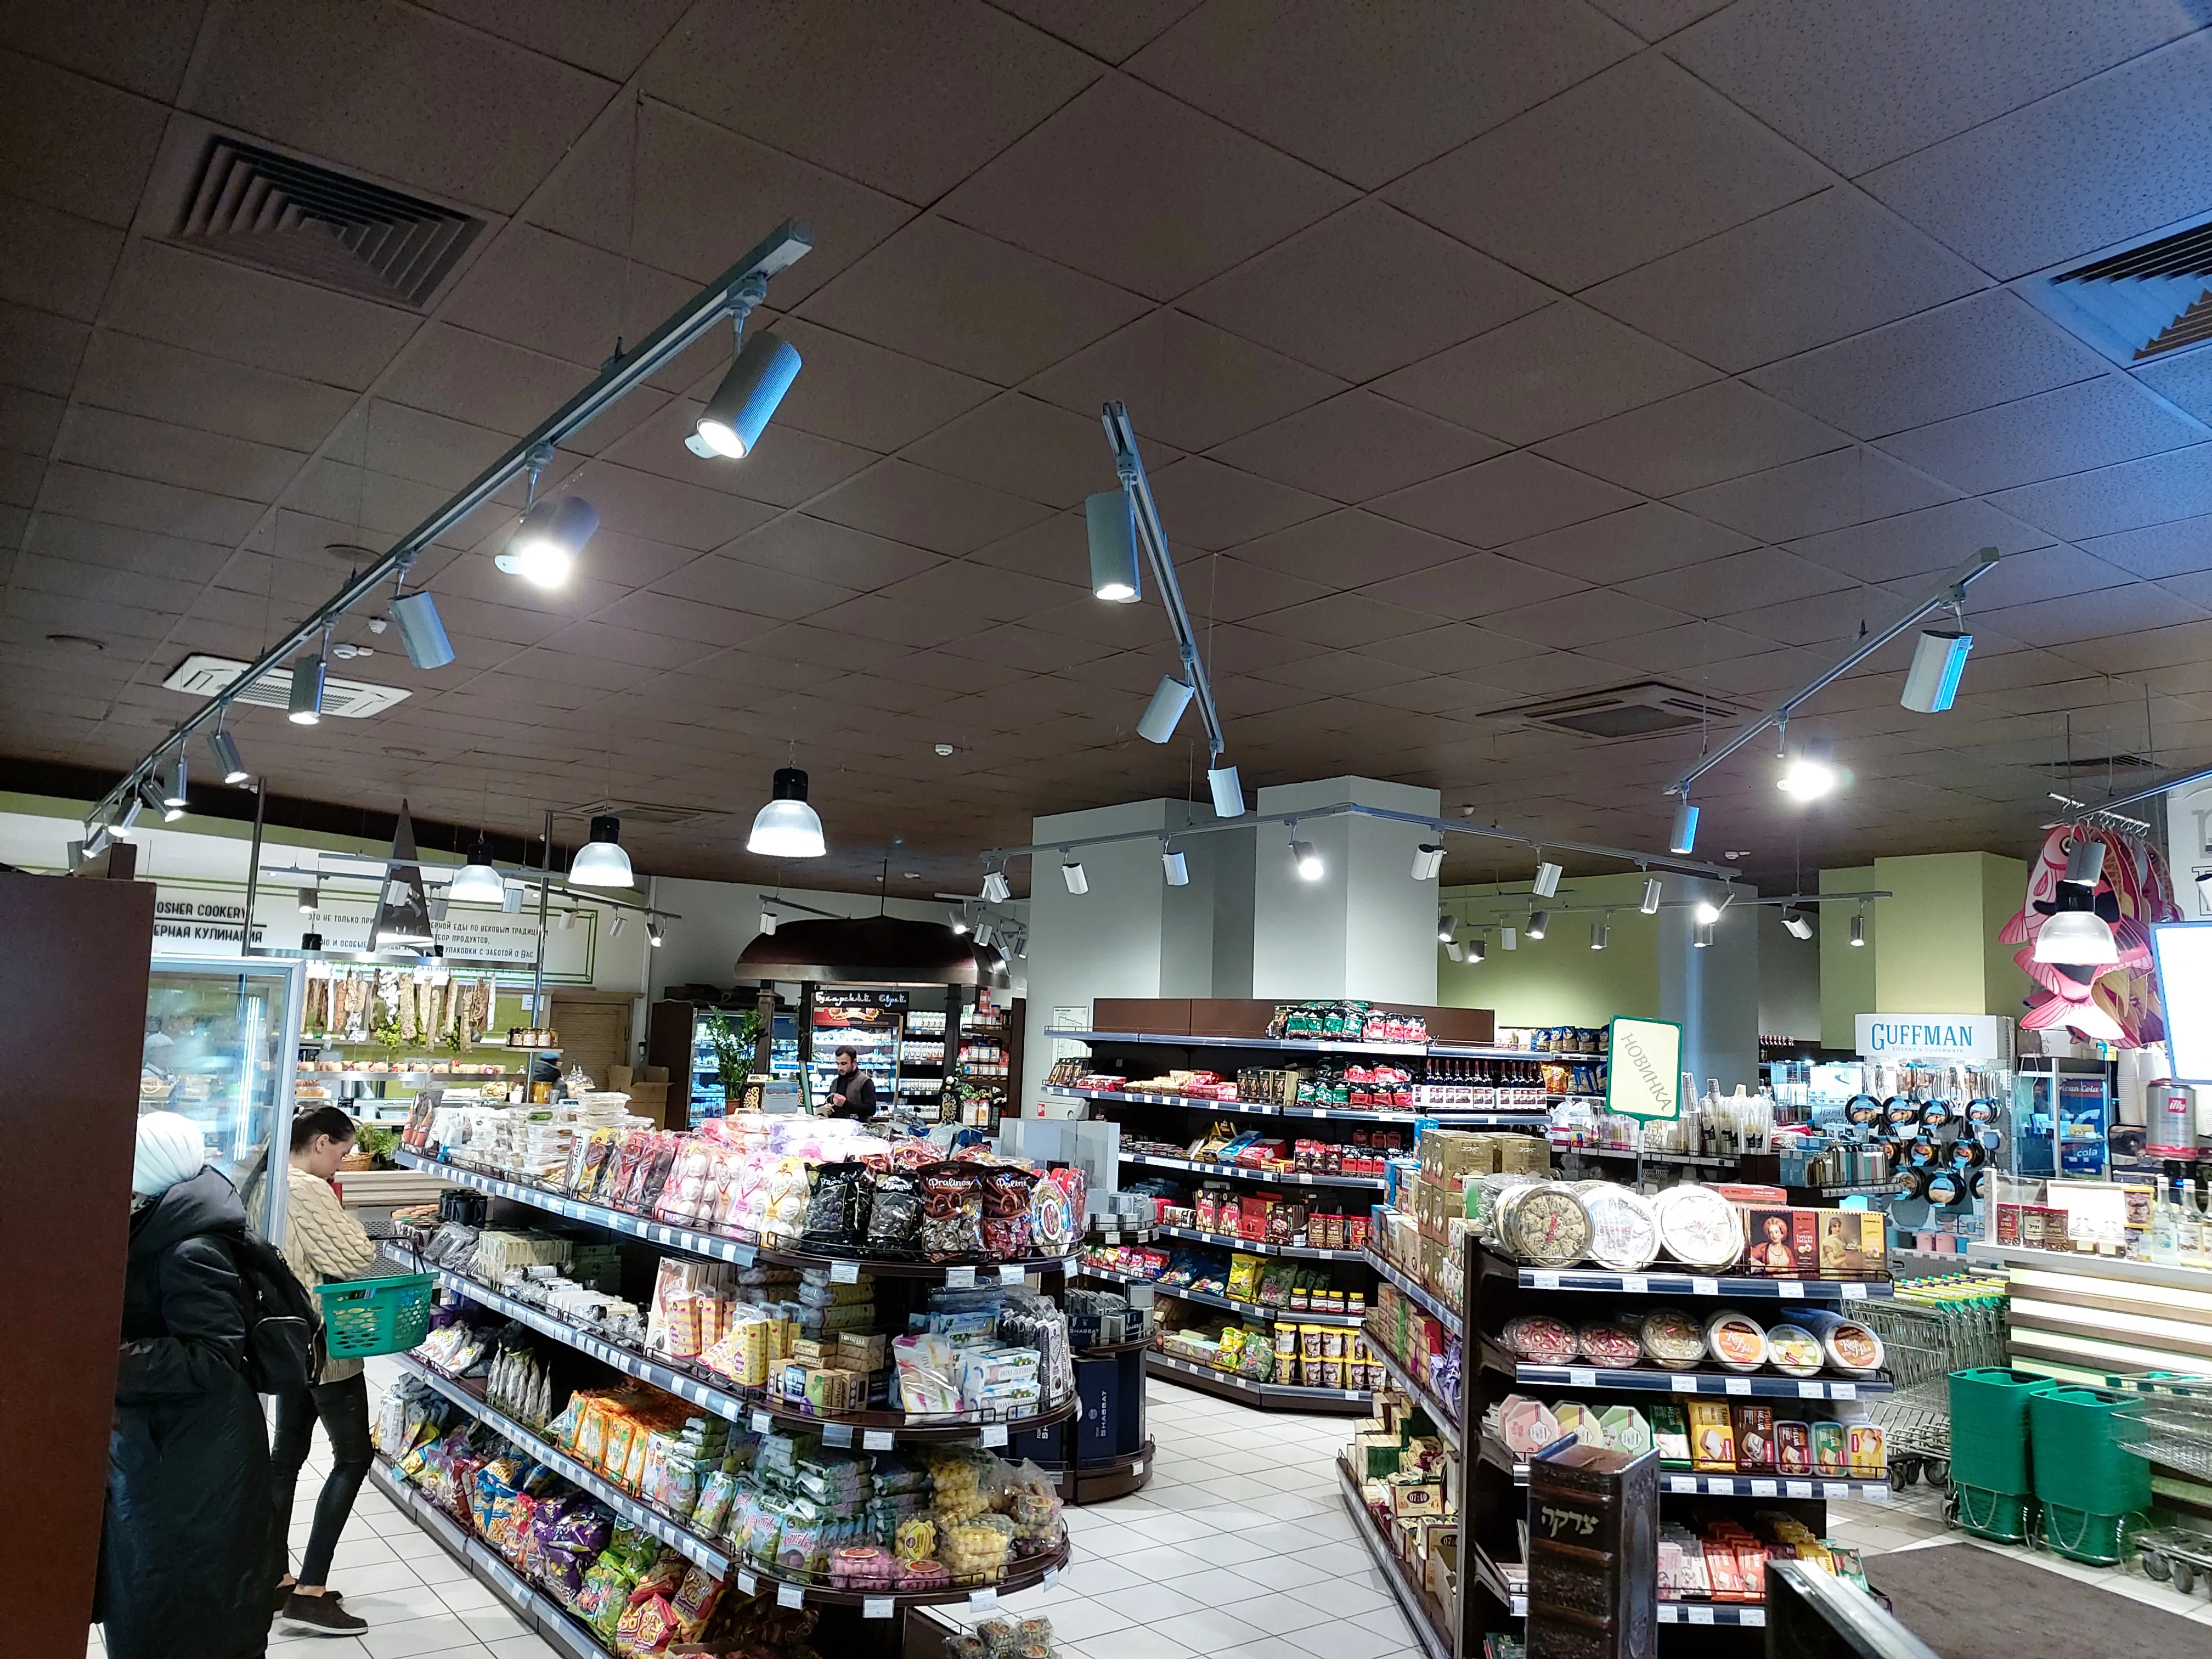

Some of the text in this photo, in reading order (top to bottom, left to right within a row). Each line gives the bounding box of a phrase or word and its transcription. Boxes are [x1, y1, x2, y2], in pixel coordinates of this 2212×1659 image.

[156, 901, 246, 919] OSHER COOKERY
[154, 924, 191, 939] ЕРНАЯ
[334, 915, 359, 924] ТОЛЬКО
[430, 921, 451, 930] ЕРНОЙ
[453, 923, 468, 932] ЕДЫ
[481, 924, 510, 934] ВЕКОВЫМ
[445, 946, 477, 955] УПАКОВКИ
[486, 948, 512, 957] ЗАБОТОЙ
[1871, 1023, 1973, 1051] GUFFMAN
[1620, 1032, 1673, 1111] НОВИНКА
[2169, 1099, 2186, 1111] illy
[2076, 1148, 2098, 1157] cola
[928, 1178, 971, 1189] Pralines
[1409, 1493, 1427, 1502] 07:40
[1541, 1505, 1600, 1538] צדקה
